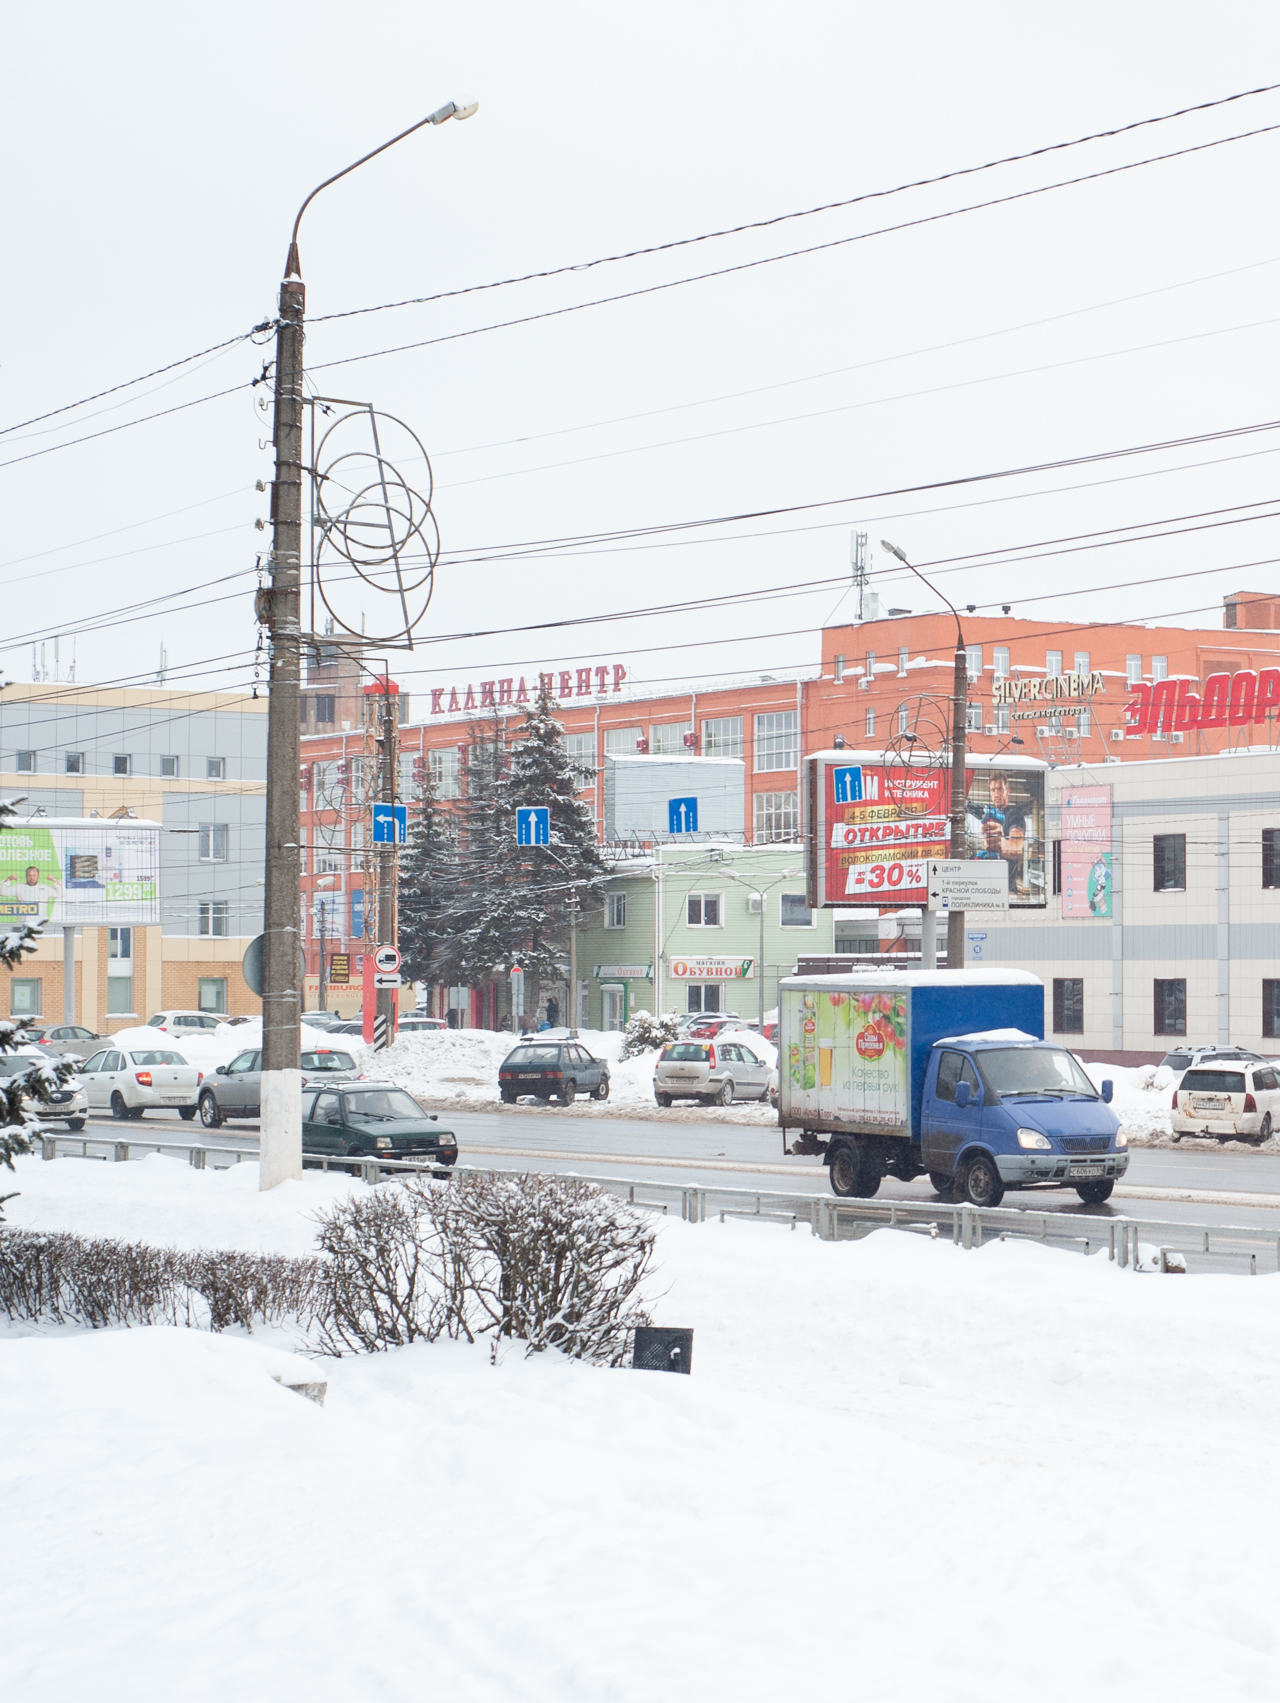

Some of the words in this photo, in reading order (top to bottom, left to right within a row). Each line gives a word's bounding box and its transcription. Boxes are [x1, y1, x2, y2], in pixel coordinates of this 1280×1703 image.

[884, 779, 938, 789] ИНСТРУМЕНТ
[884, 789, 890, 797] И
[849, 811, 865, 820] 4-5
[1066, 813, 1095, 828] УМНЫЕ
[844, 822, 946, 844] ОТКРЫТИЕ
[1066, 828, 1106, 844] ПОКУПКИ
[0, 835, 34, 847] ОТОВЬ
[0, 849, 52, 861] ОЛЕЗНОЕ
[841, 850, 918, 864] ВОЛОКОЛАМСКИЙ
[942, 866, 961, 874] ЦЕНТР
[107, 883, 142, 900] 1299
[851, 1066, 889, 1079] Качество
[842, 1081, 851, 1089] из
[852, 1082, 880, 1093] первых
